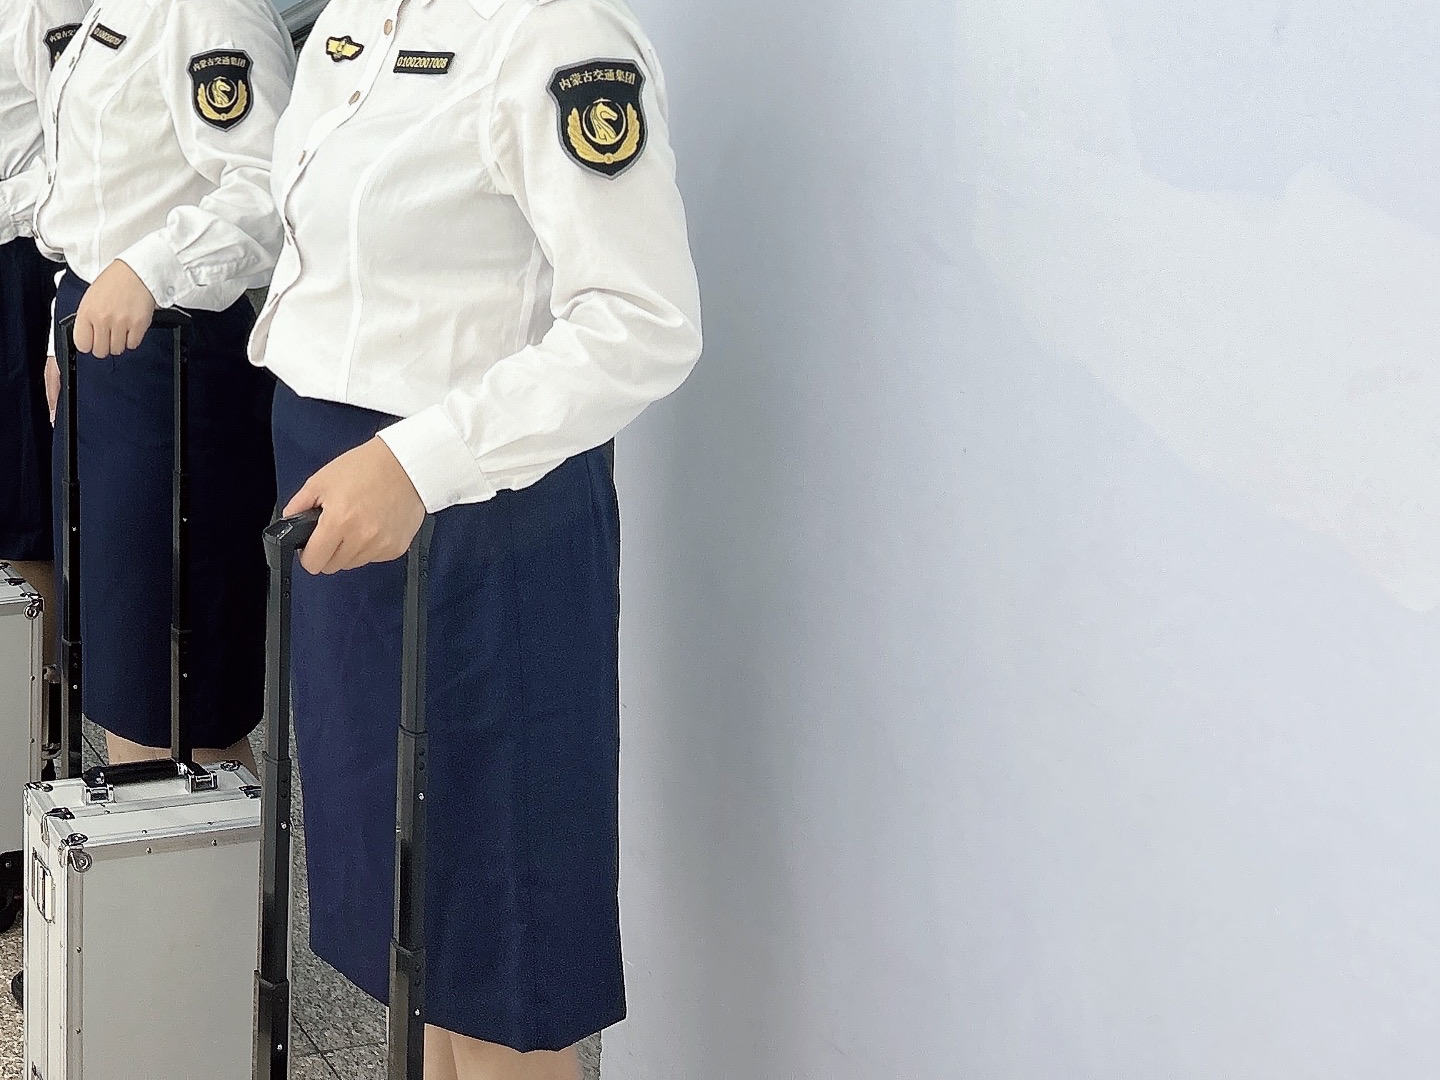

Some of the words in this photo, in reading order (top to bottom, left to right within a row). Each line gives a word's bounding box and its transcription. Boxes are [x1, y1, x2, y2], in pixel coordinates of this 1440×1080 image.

[559, 69, 636, 92] 内蒙古交通集团
